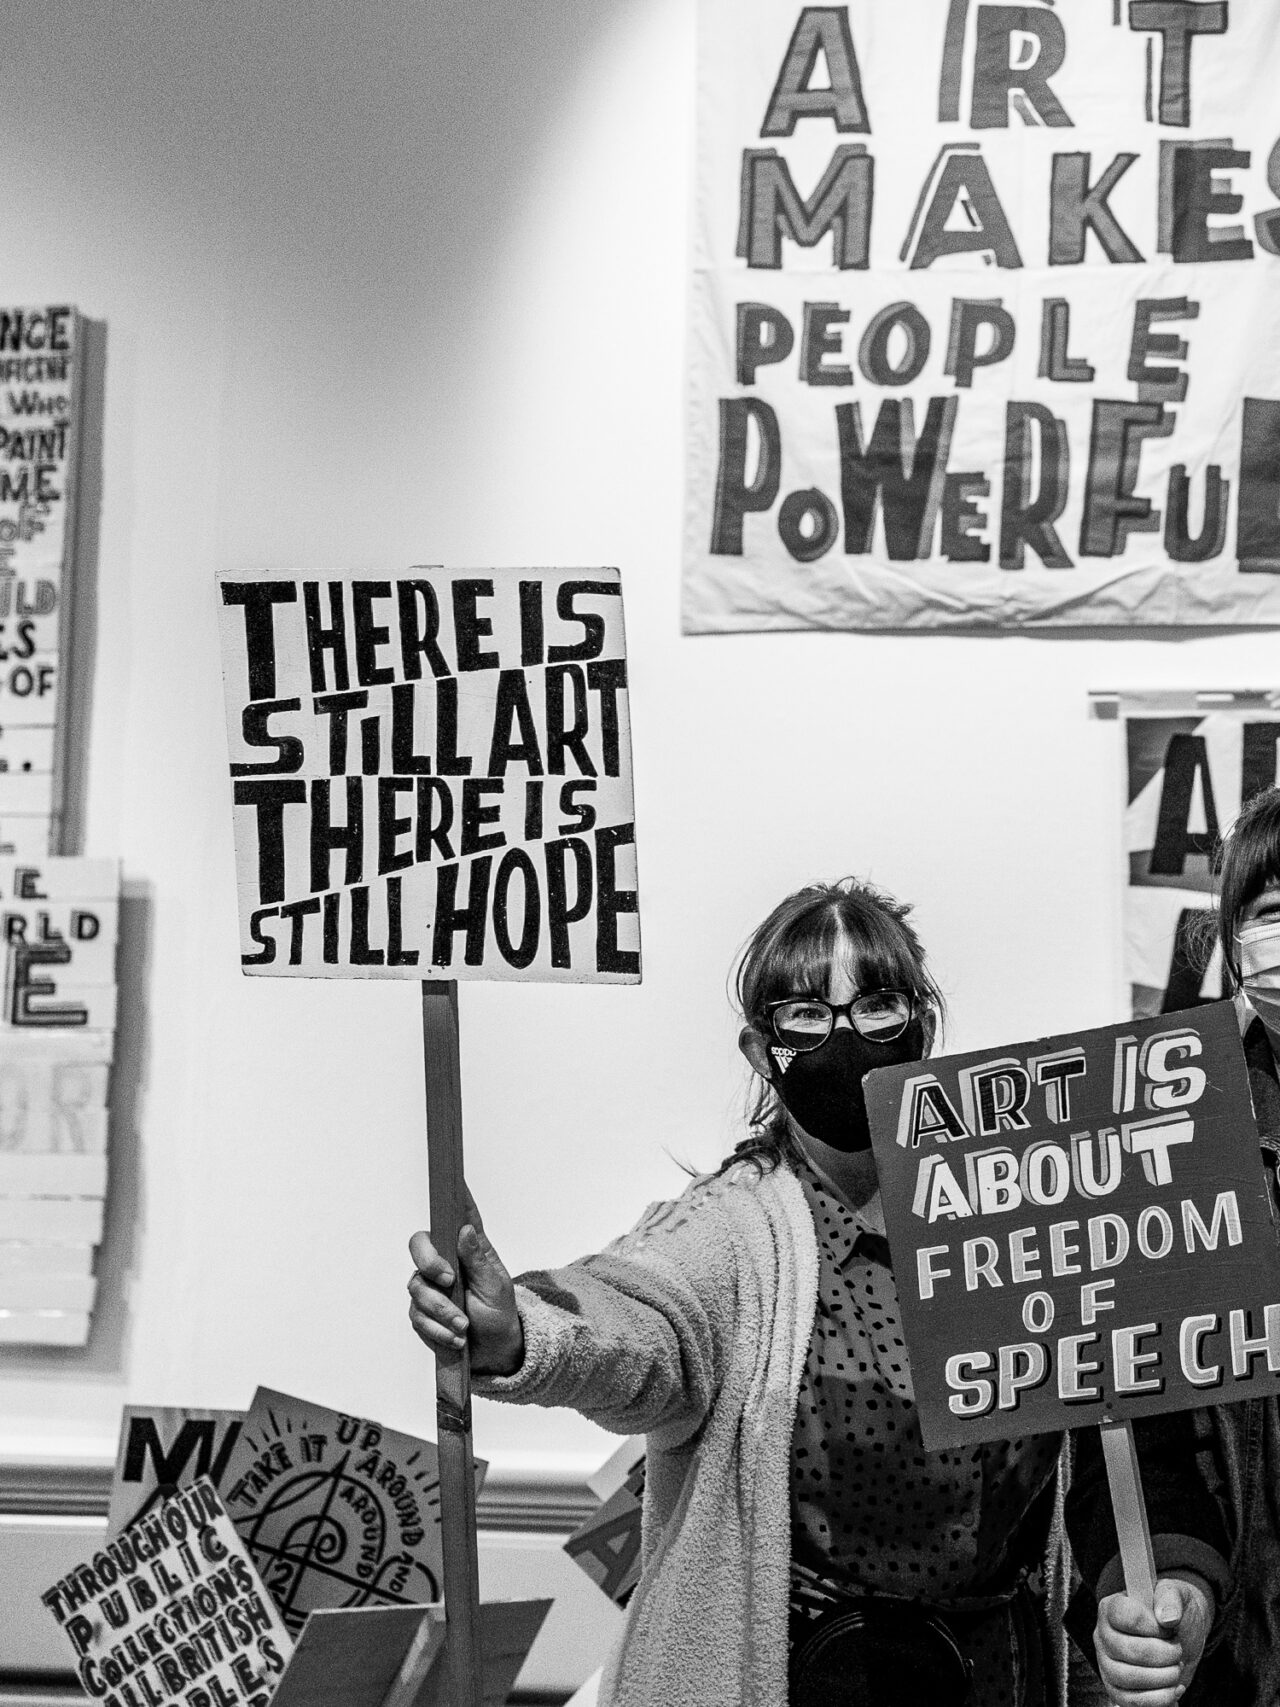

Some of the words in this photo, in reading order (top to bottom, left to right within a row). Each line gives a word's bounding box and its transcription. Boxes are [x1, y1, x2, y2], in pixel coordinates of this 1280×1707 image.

[760, 0, 1228, 137] ART
[736, 297, 1199, 400] PEOPLE
[221, 579, 500, 701] THERE
[519, 580, 621, 666] IS
[230, 677, 472, 777] STILL
[488, 659, 627, 777] ART
[234, 776, 507, 905] THERE
[525, 780, 597, 841] IS
[241, 876, 419, 966] STILL
[432, 822, 640, 974] HOPE
[897, 1047, 1086, 1148] ART
[1113, 1028, 1207, 1114] IS
[912, 1111, 1195, 1223] ABOUT
[916, 1190, 1243, 1300] FREEDOM
[1022, 1279, 1115, 1333] OF
[227, 1442, 293, 1507] TAKE
[300, 1434, 328, 1462] IT
[337, 1414, 382, 1451] UP
[339, 1486, 377, 1578] AROUND
[354, 1449, 425, 1547] AROUND
[65, 1524, 228, 1656] PUBLIC
[77, 1555, 254, 1698] COLLECTIONS
[154, 1591, 273, 1697] BRITISH
